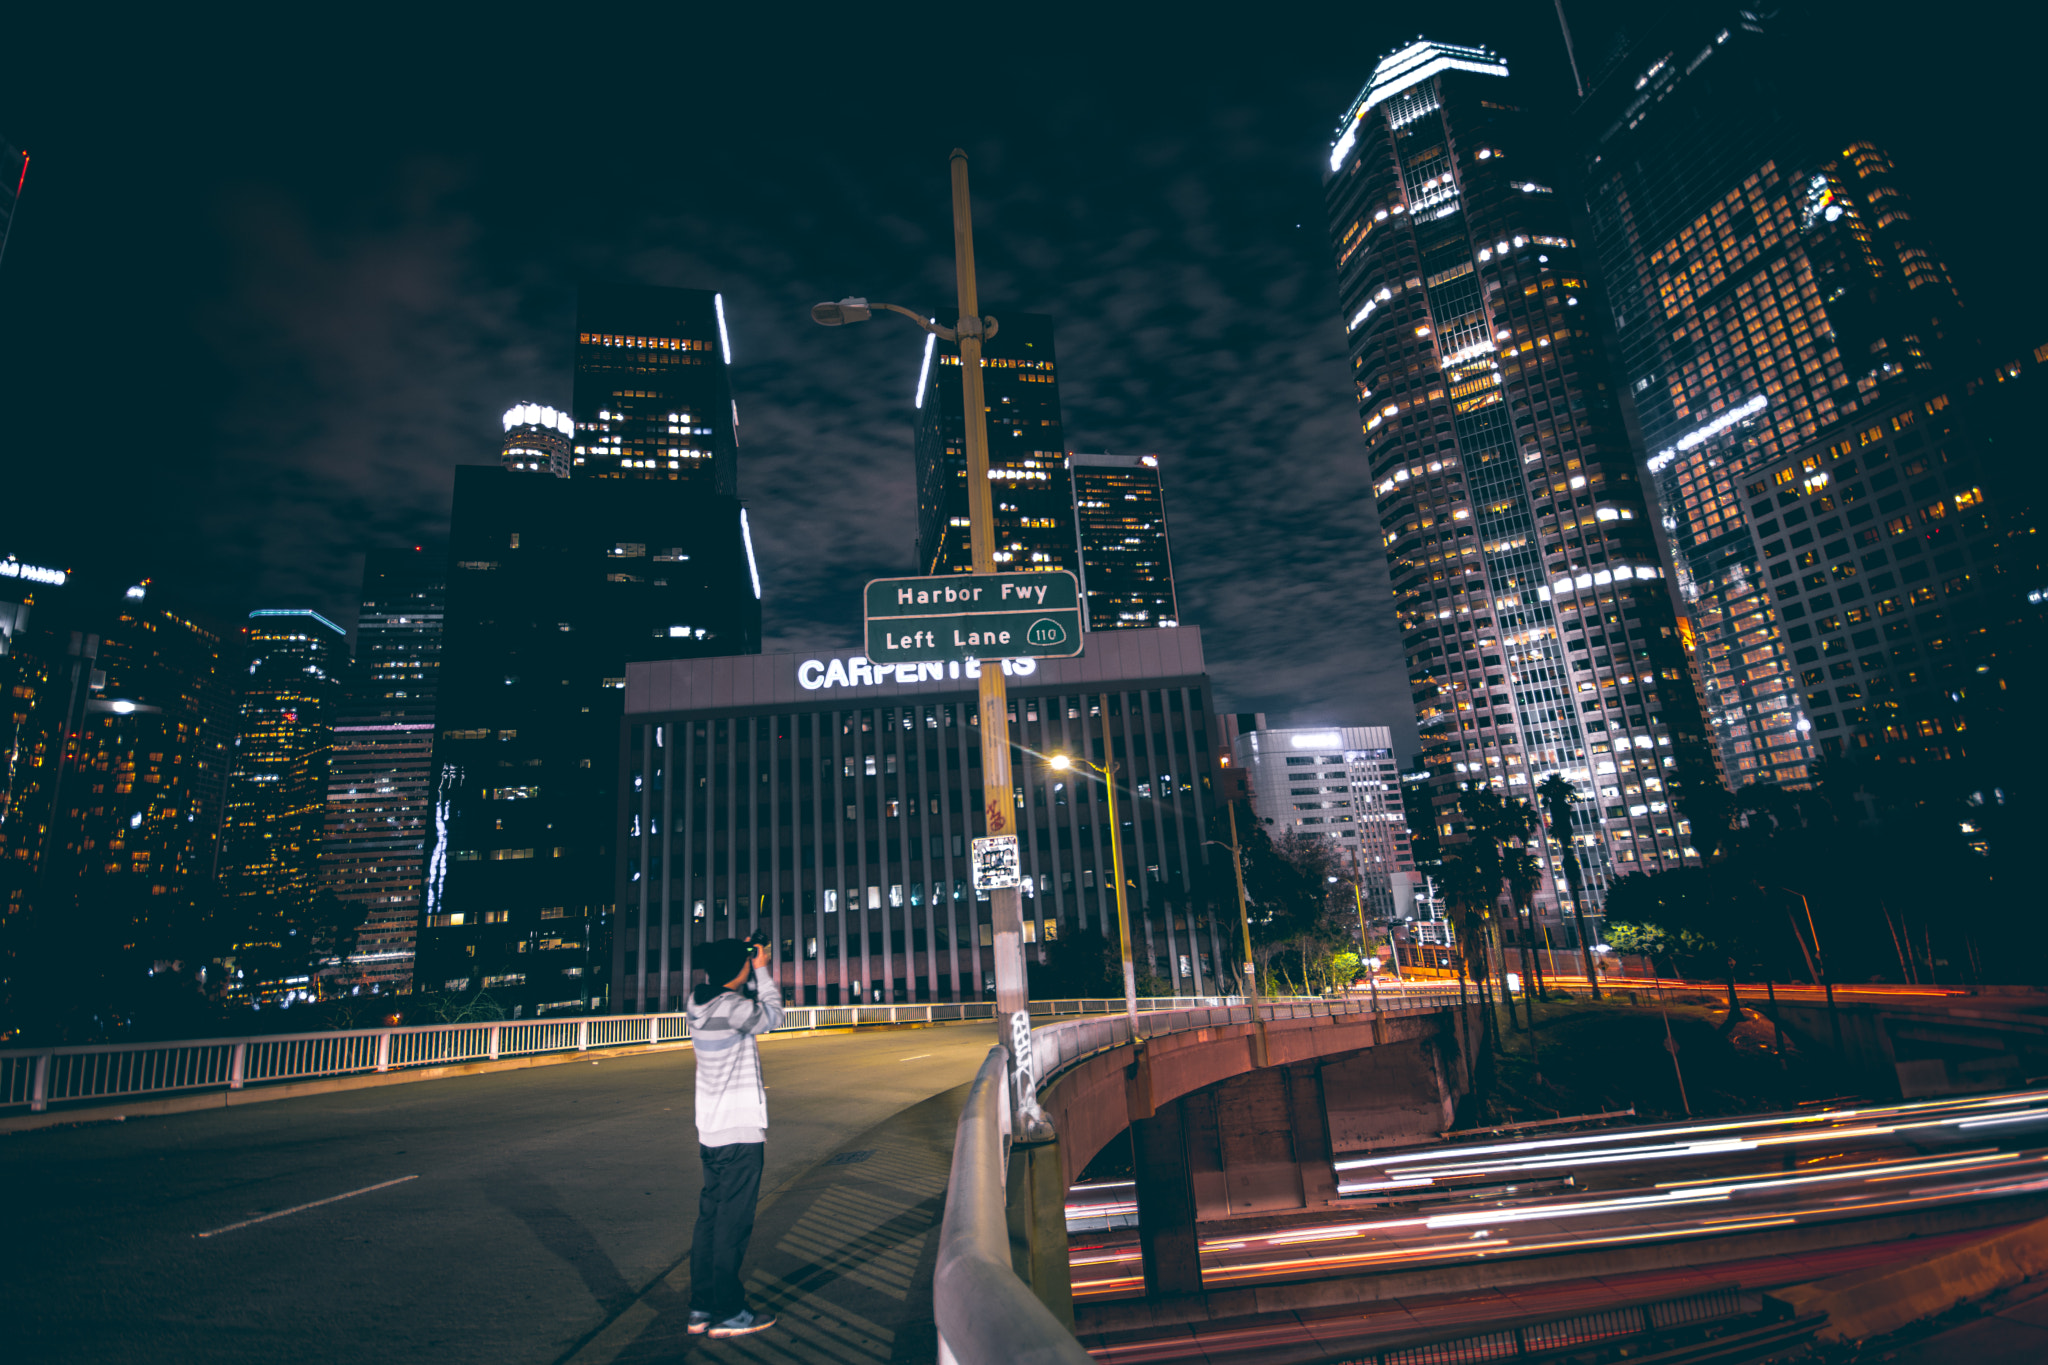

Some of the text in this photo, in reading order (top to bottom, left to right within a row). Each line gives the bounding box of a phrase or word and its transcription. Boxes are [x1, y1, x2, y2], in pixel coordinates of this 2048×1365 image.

[897, 583, 1048, 605] Harbor Fwy
[886, 629, 1011, 649] Left Lane
[1036, 629, 1056, 641] 110
[798, 657, 1036, 689] CARPENES
